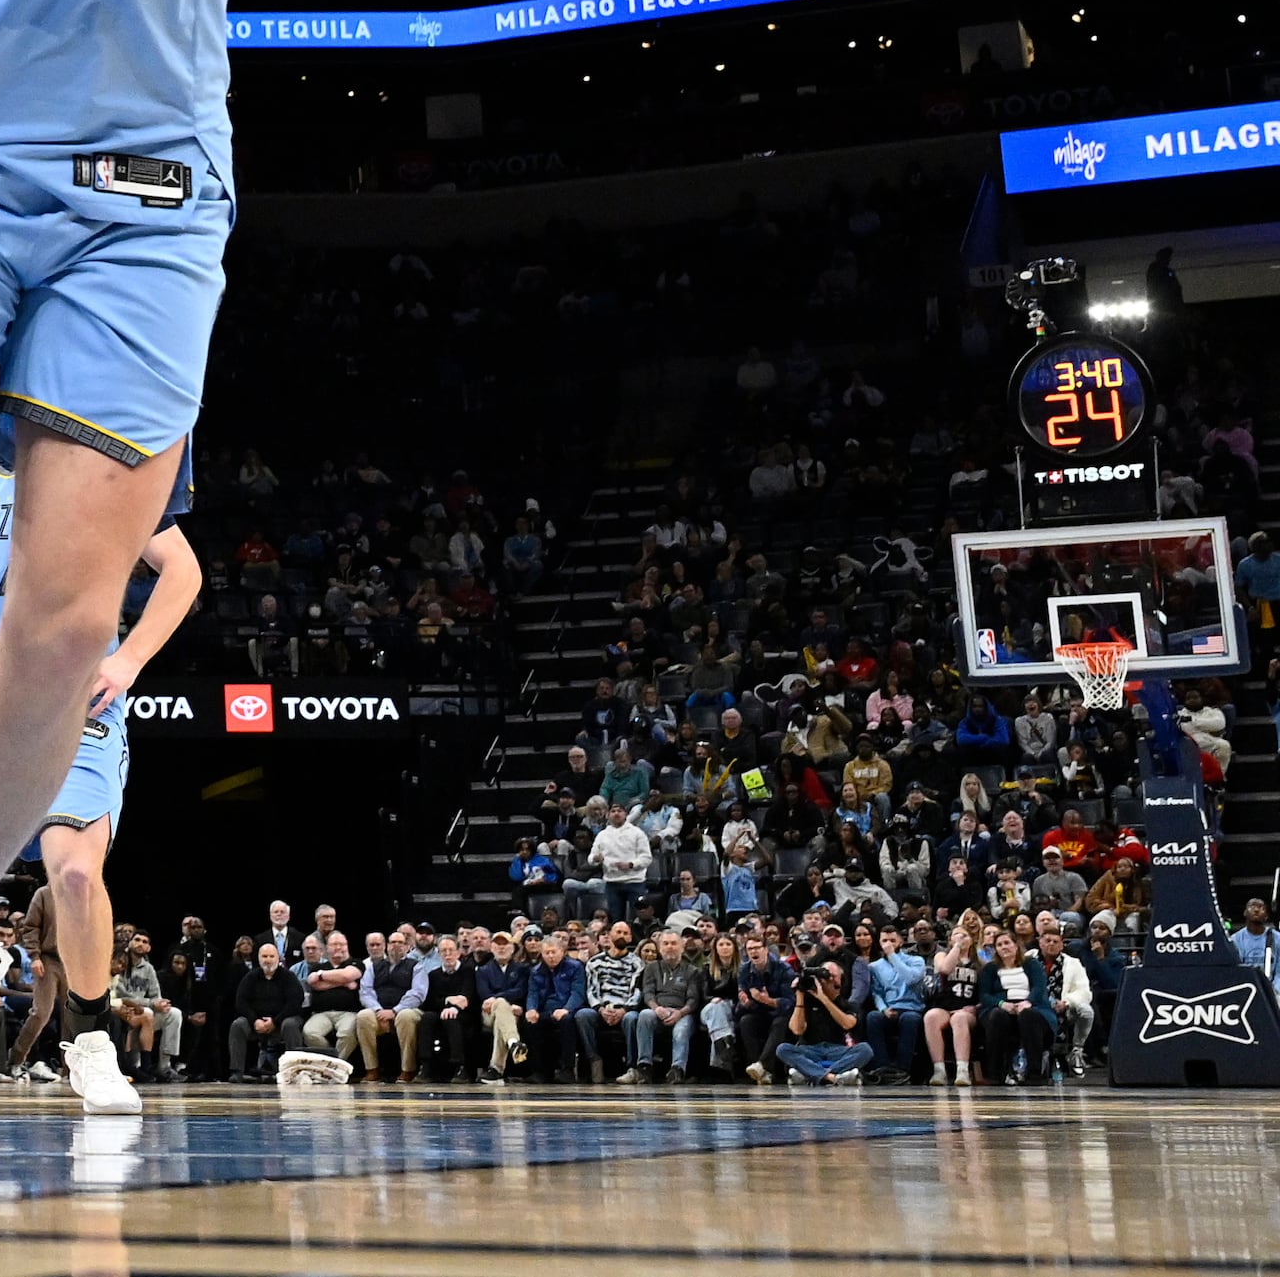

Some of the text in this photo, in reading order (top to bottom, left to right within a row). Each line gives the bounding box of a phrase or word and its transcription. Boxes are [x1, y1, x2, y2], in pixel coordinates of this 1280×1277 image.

[262, 19, 372, 40] TEQUILA
[1053, 129, 1107, 181] milagro
[978, 267, 1006, 284] 101
[1054, 357, 1123, 392] 3:40
[1045, 389, 1123, 447] 24
[1063, 463, 1144, 484] TISSOT
[282, 696, 400, 721] TOYOTA
[1152, 855, 1198, 866] GOSSETT
[1156, 940, 1215, 954] GOSSETT
[951, 982, 974, 999] 45
[1153, 1003, 1240, 1027] SONIC
